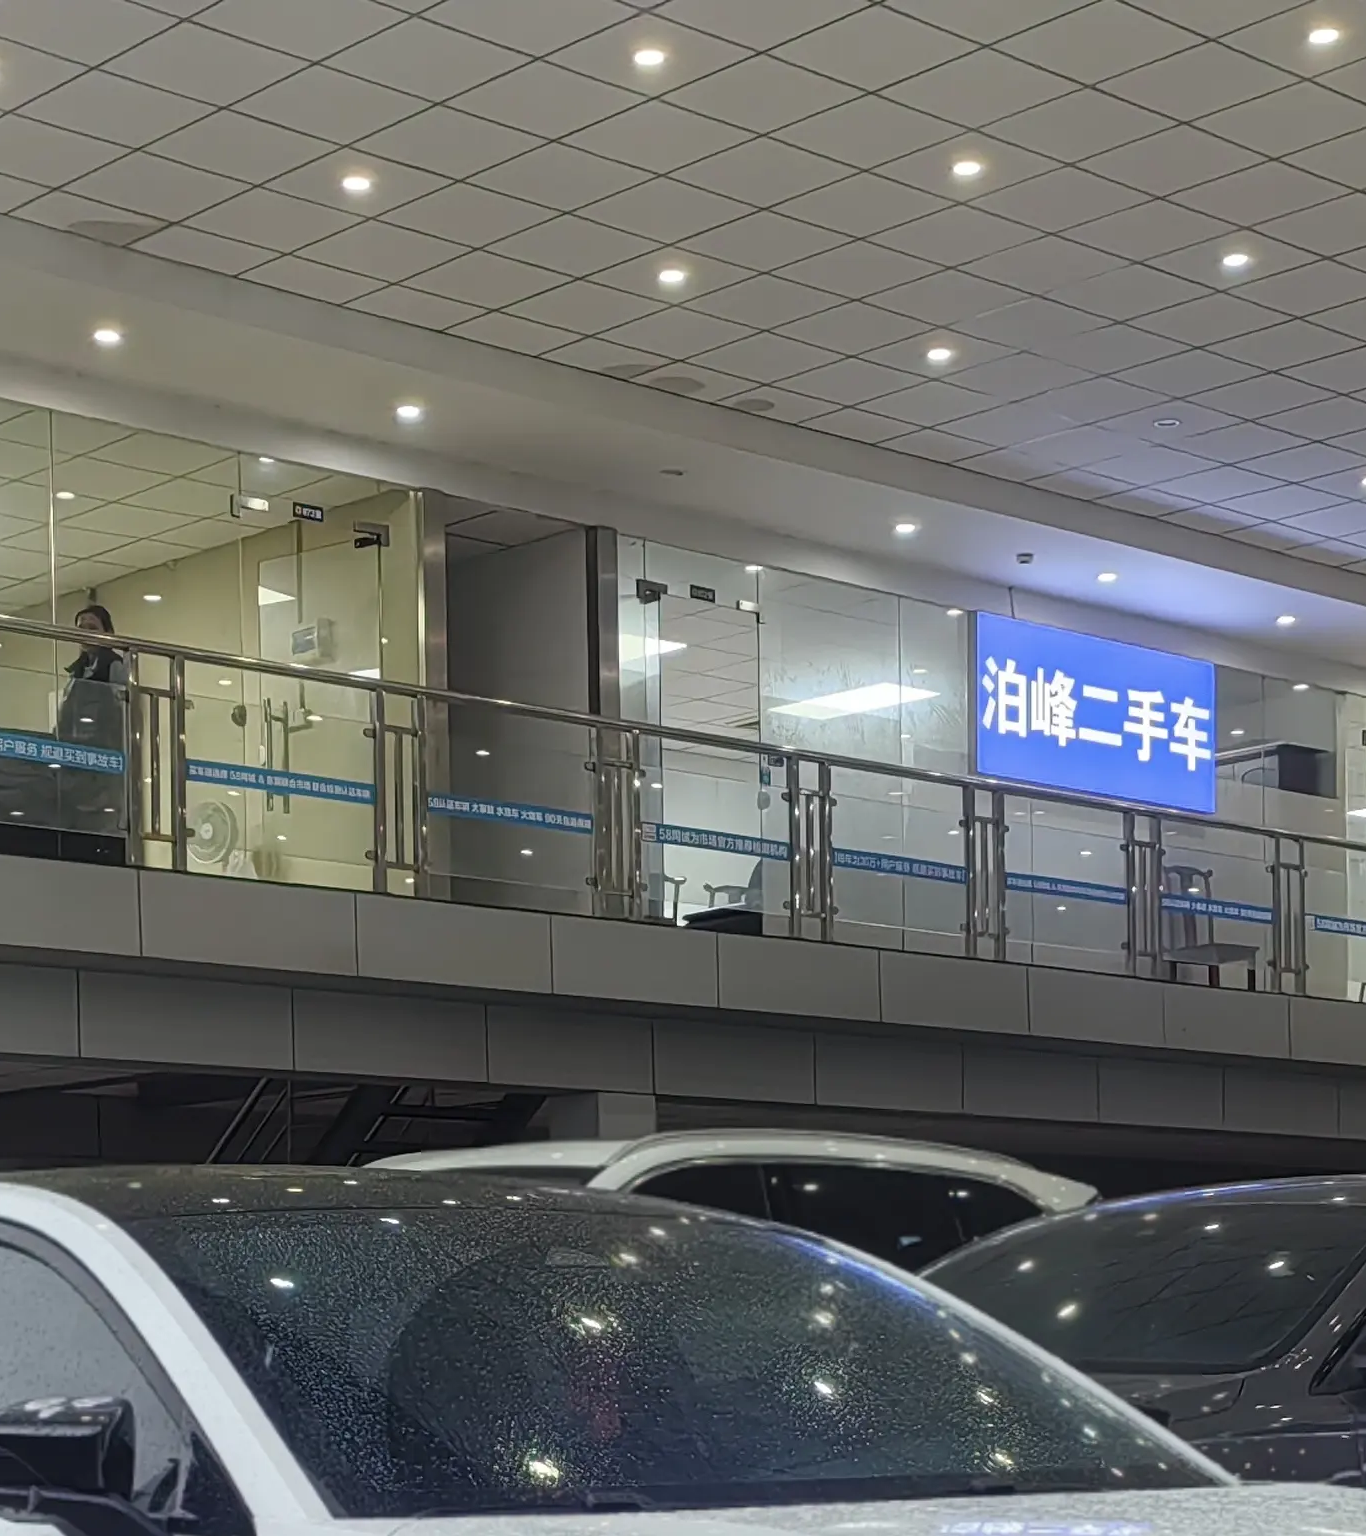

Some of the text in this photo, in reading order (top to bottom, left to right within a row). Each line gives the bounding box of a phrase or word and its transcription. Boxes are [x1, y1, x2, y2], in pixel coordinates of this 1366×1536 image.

[982, 656, 1212, 772] 泊峰二手车
